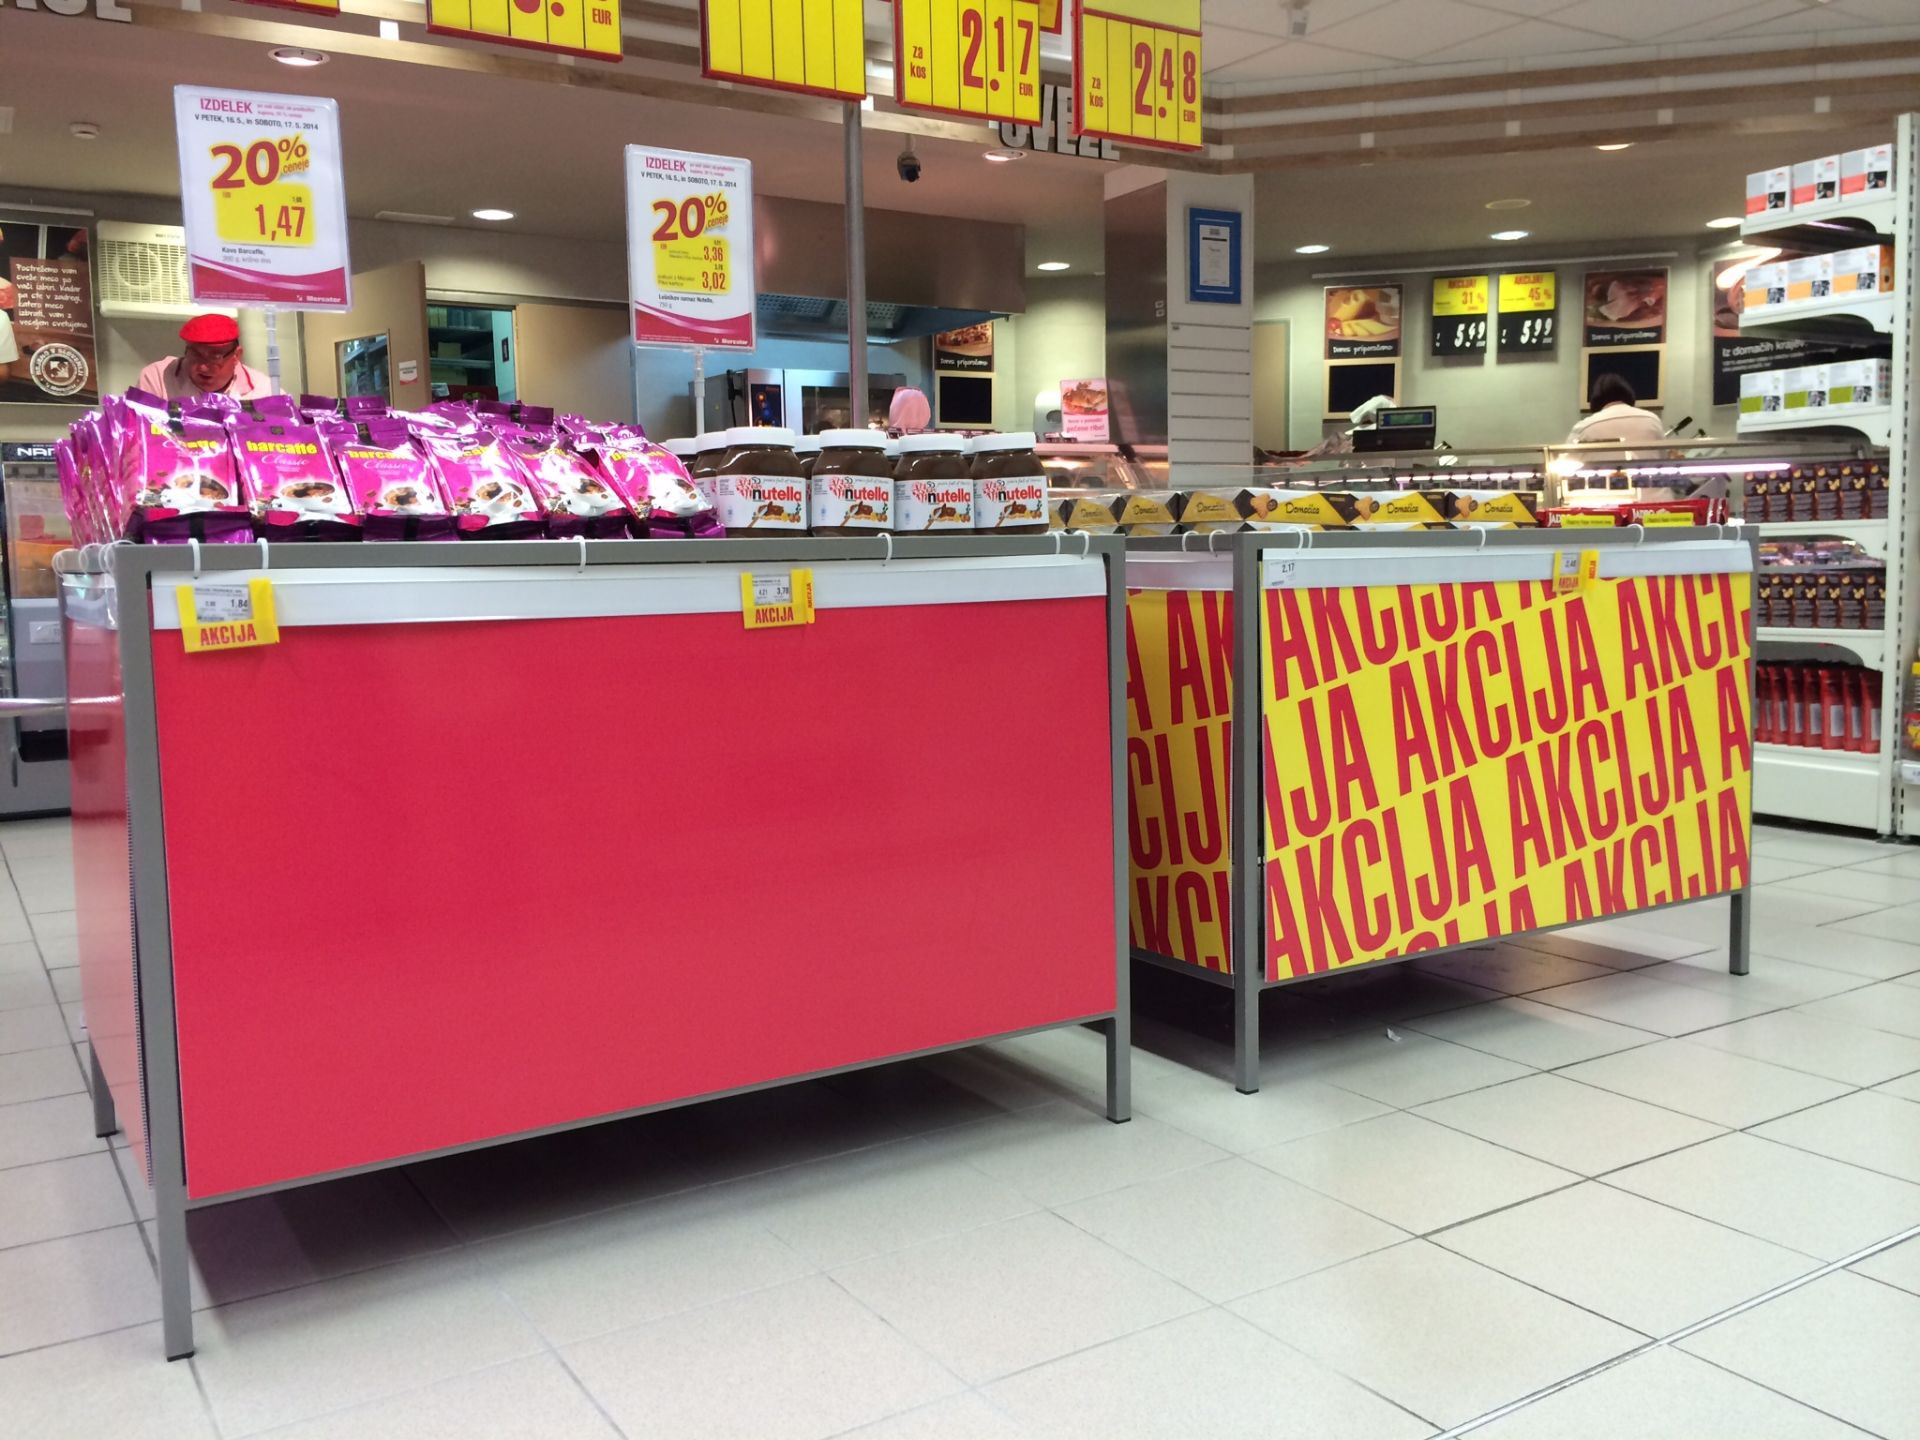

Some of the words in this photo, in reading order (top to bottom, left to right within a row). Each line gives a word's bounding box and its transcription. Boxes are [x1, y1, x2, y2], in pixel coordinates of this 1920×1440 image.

[592, 8, 612, 26] EUR
[912, 45, 923, 59] za
[962, 8, 1034, 92] 2.17
[910, 61, 926, 79] kos
[1091, 76, 1101, 90] za
[1134, 42, 1196, 118] 2.48
[1019, 83, 1033, 97] EUR
[200, 98, 252, 113] IZDELEK
[1089, 92, 1104, 108] kos
[1183, 109, 1196, 123] EUR
[282, 158, 310, 174] ceneje
[645, 156, 686, 172] IZDELEK
[255, 204, 306, 241] 1,47
[707, 215, 729, 228] ceneje
[703, 246, 724, 262] 3,36
[702, 271, 726, 291] 3,02
[1462, 291, 1474, 305] 31
[1527, 287, 1541, 300] 45
[753, 486, 802, 502] nutella
[845, 486, 889, 502] nutella
[928, 488, 971, 503] nutella
[998, 485, 1042, 501] nutella
[755, 607, 794, 624] AKCIJA
[200, 623, 257, 646] AKCIJA
[1389, 597, 1610, 797] AKCIJA
[1127, 720, 1232, 870] CIJ
[1264, 774, 1497, 984] AKCIJA
[1505, 684, 1708, 880] AKCIJA
